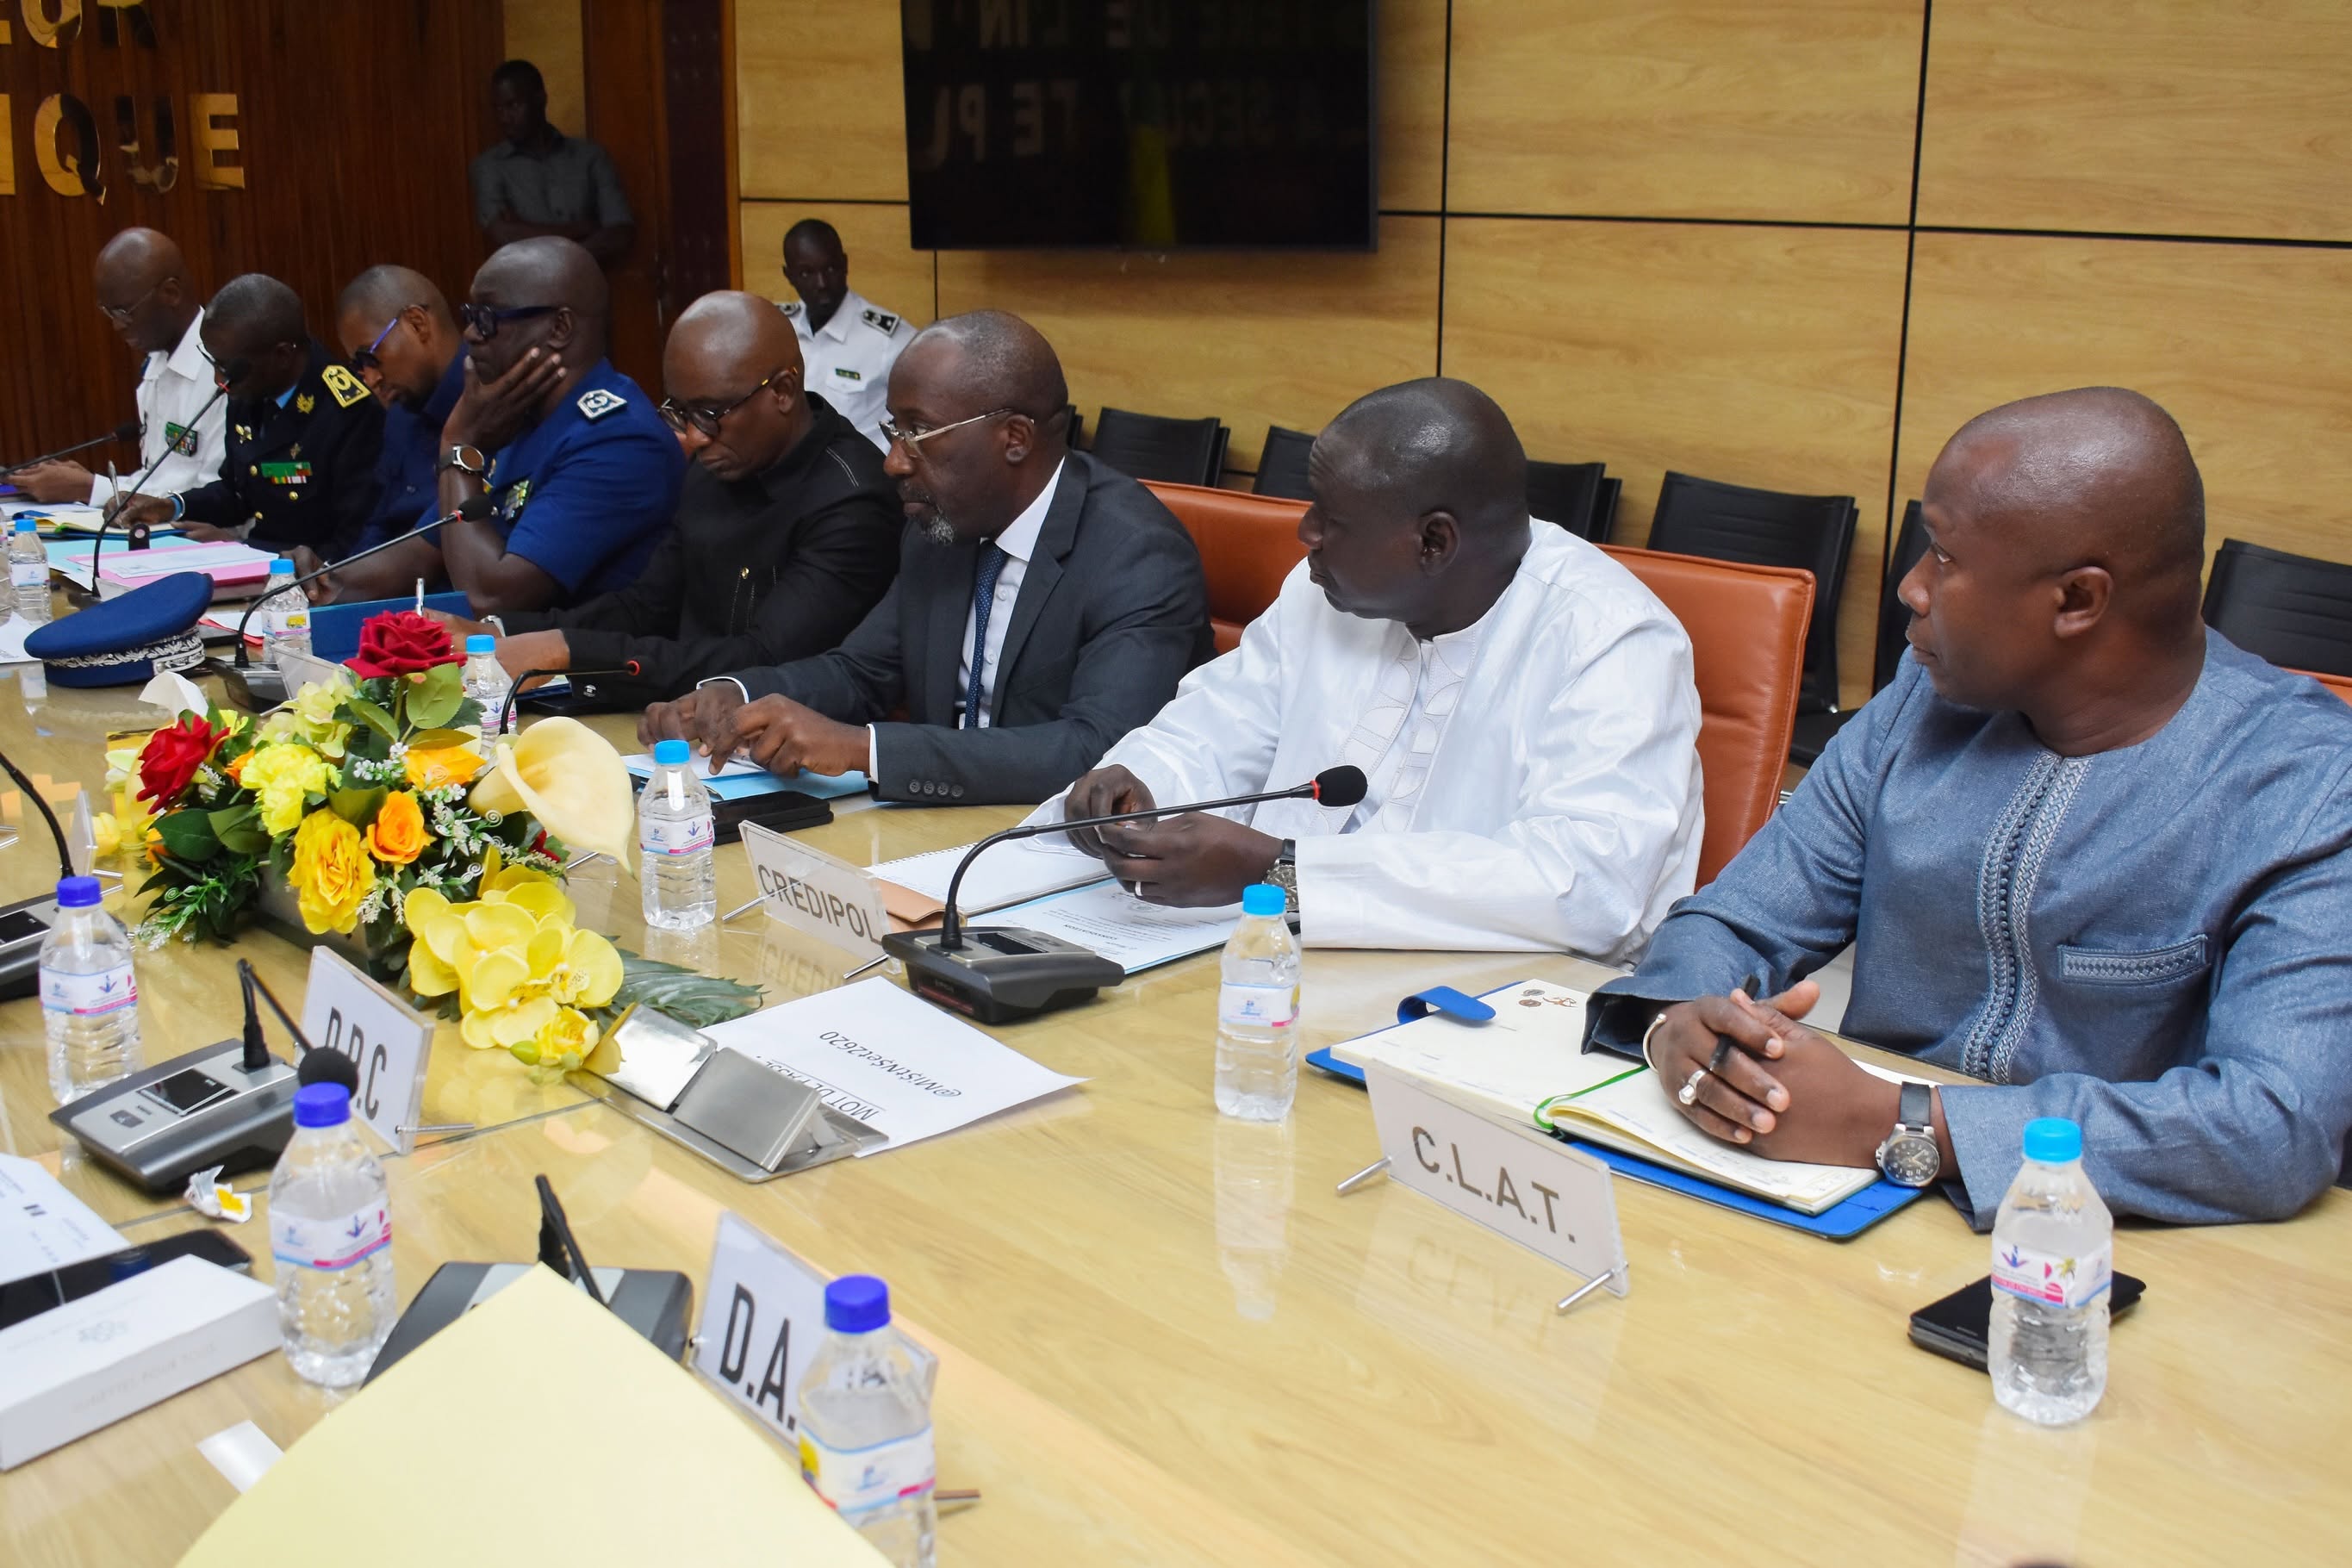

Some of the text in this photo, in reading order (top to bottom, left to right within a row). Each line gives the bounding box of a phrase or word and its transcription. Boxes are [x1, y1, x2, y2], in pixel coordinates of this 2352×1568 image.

[757, 864, 883, 946] CREDIPOL
[827, 1096, 880, 1121] MOT
[1412, 1126, 1576, 1244] C.L.A.T.
